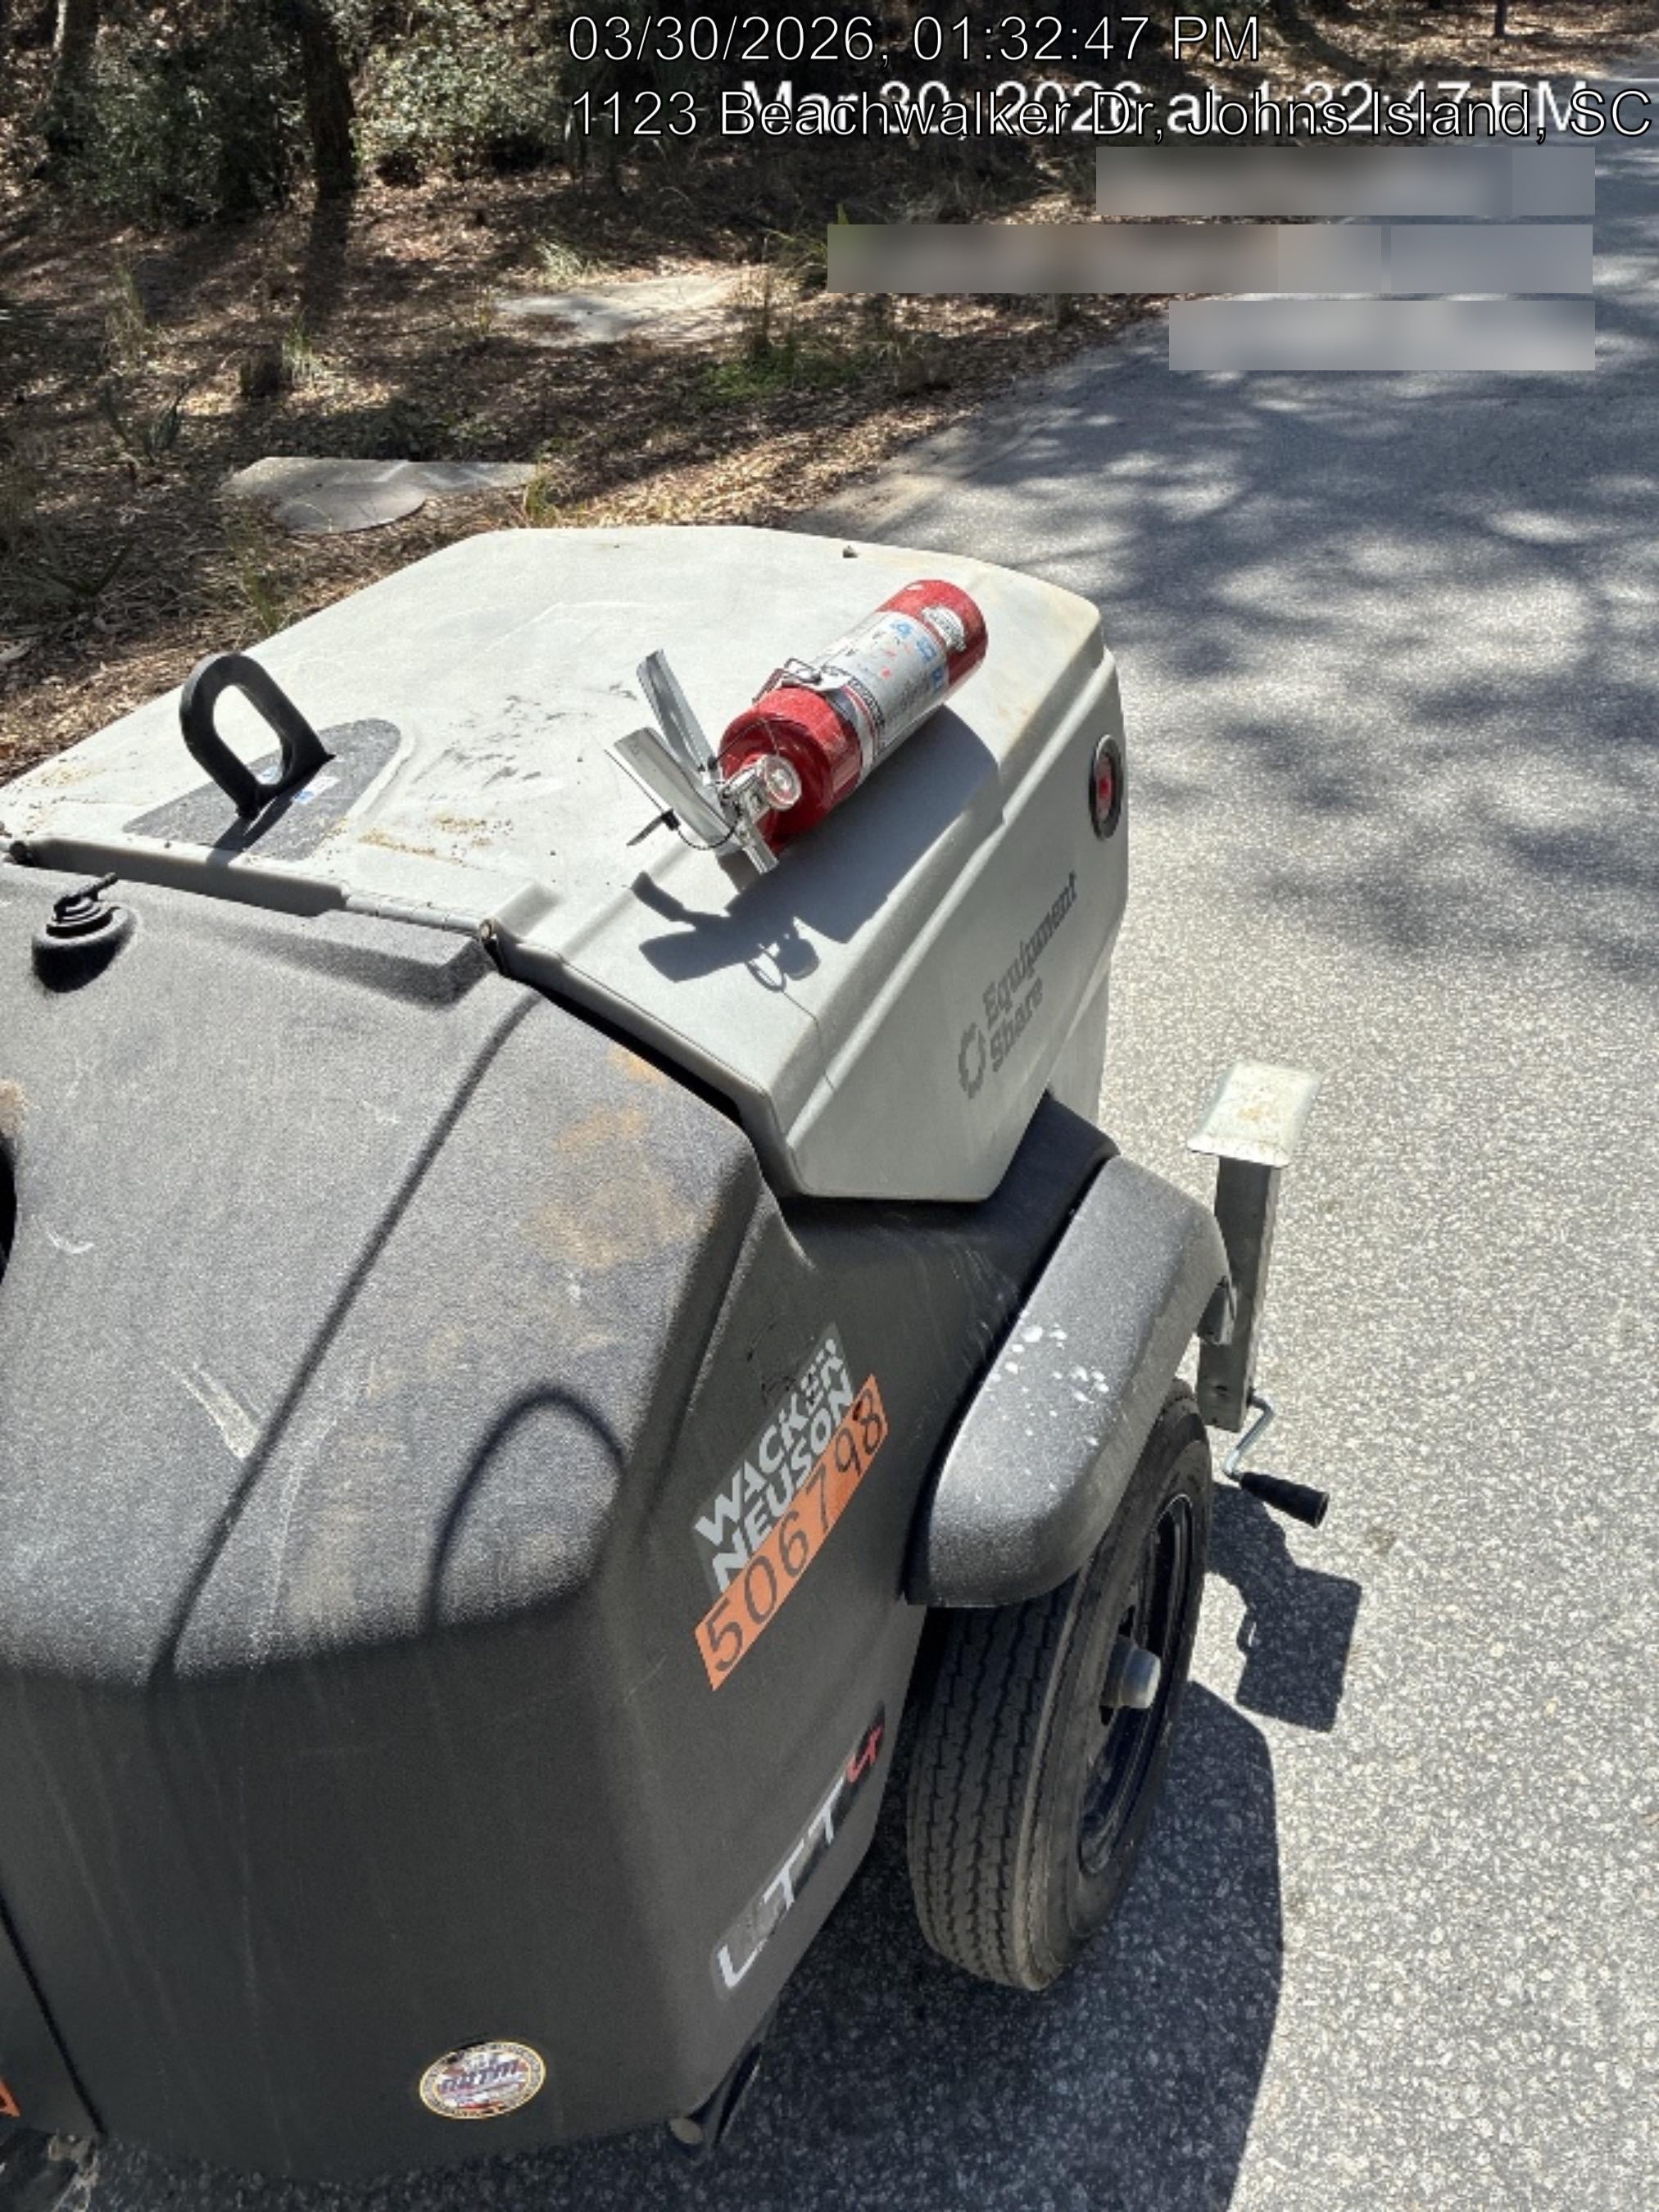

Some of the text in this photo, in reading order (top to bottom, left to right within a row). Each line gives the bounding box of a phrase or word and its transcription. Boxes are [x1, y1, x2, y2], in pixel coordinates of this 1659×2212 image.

[982, 869, 1078, 1030] Equipment
[990, 977, 1044, 1072] Share
[695, 1338, 845, 1546] WACKER
[705, 1388, 885, 1673] 506798
[711, 1367, 854, 1593] NEUSON
